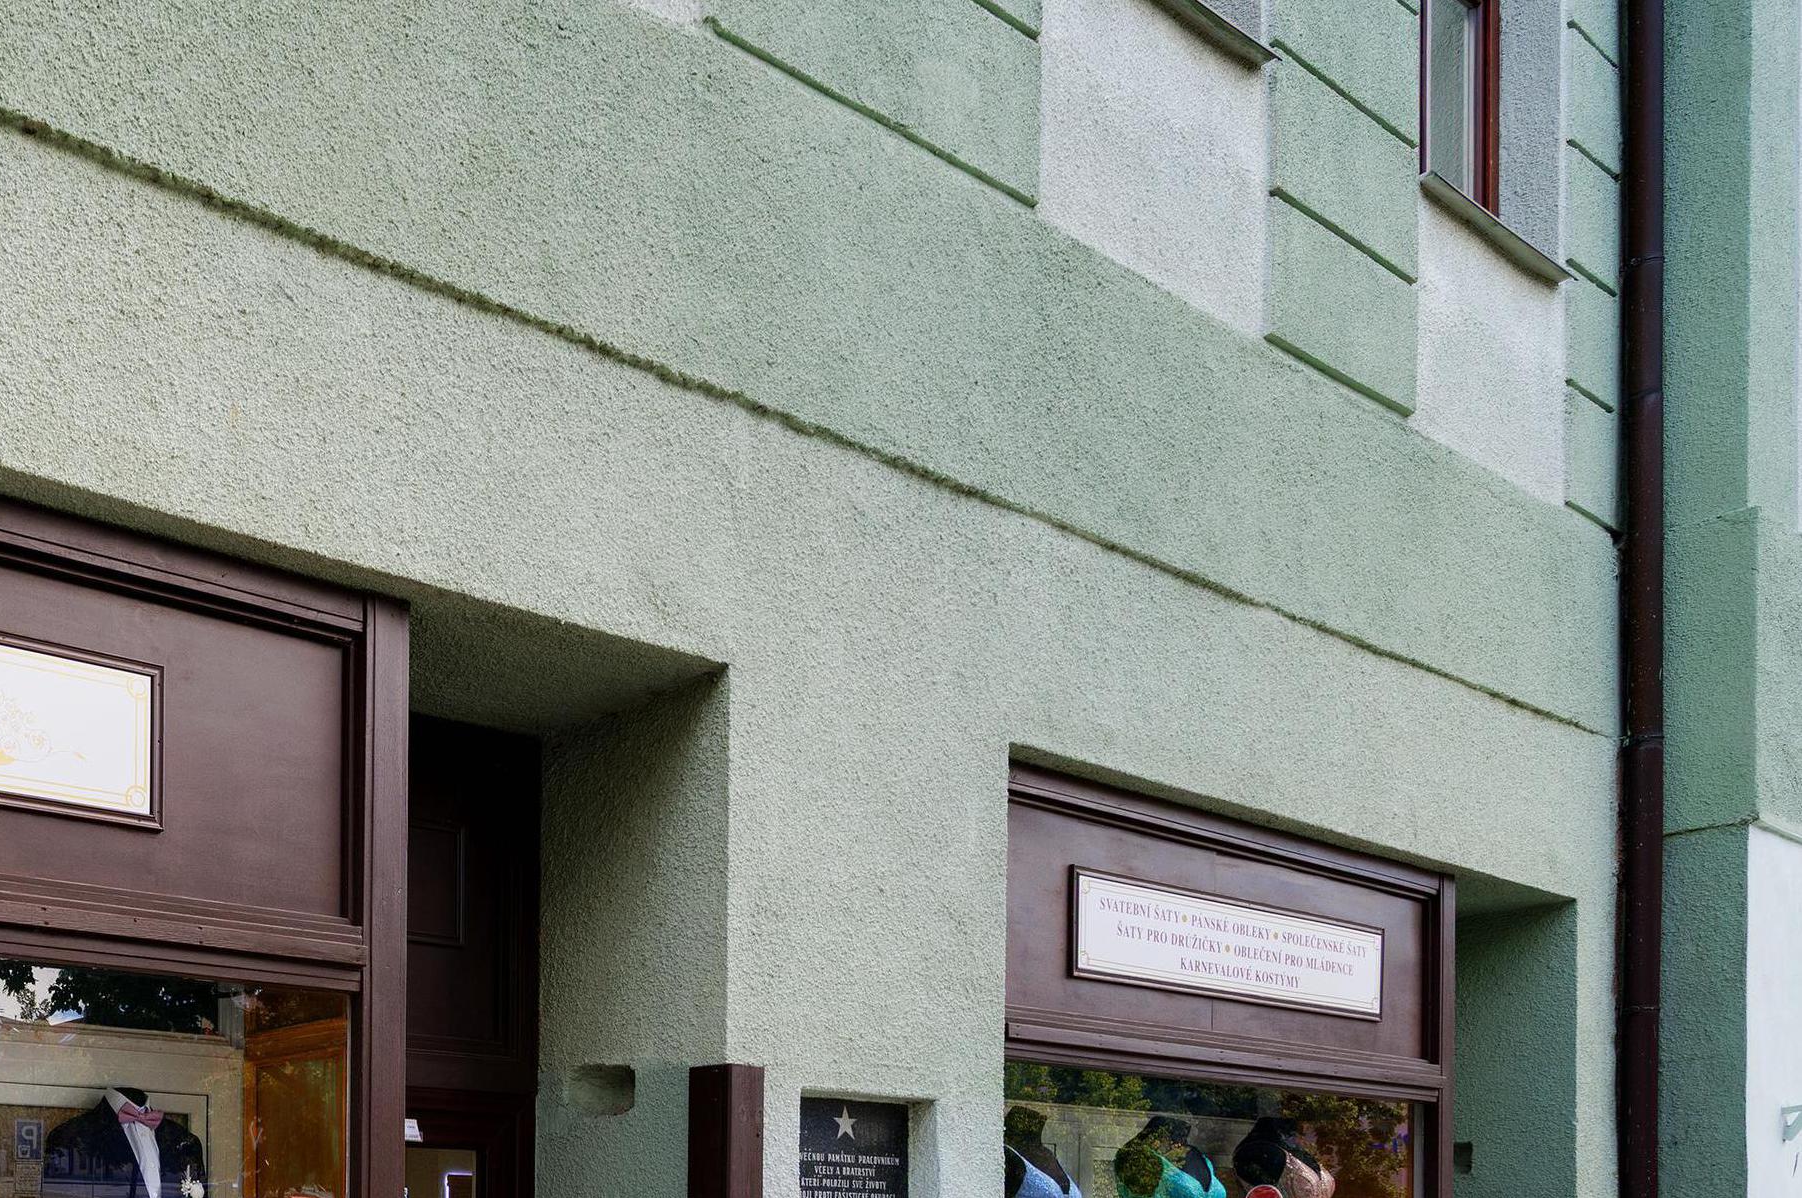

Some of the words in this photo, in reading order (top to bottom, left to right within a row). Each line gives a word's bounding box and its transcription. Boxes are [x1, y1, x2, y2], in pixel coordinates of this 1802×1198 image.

[1099, 896, 1152, 918] SVATEBNÍ
[1155, 903, 1181, 923] ŠATY
[1191, 912, 1230, 933] PÁNSKÉ
[1232, 922, 1272, 941] OBLEKY
[1282, 930, 1345, 955] SPOLEČENSKÉ
[1346, 941, 1367, 959] ŠATY
[1117, 920, 1144, 940] ŠATY
[1147, 929, 1168, 945] PRO
[1233, 943, 1283, 964] OBLEČENÍ
[1285, 954, 1304, 968] PRO
[1306, 956, 1354, 977] MLÁDENCE
[1180, 957, 1252, 981] KARNEVALOVÉ
[1255, 971, 1301, 989] KOSTÝMY
